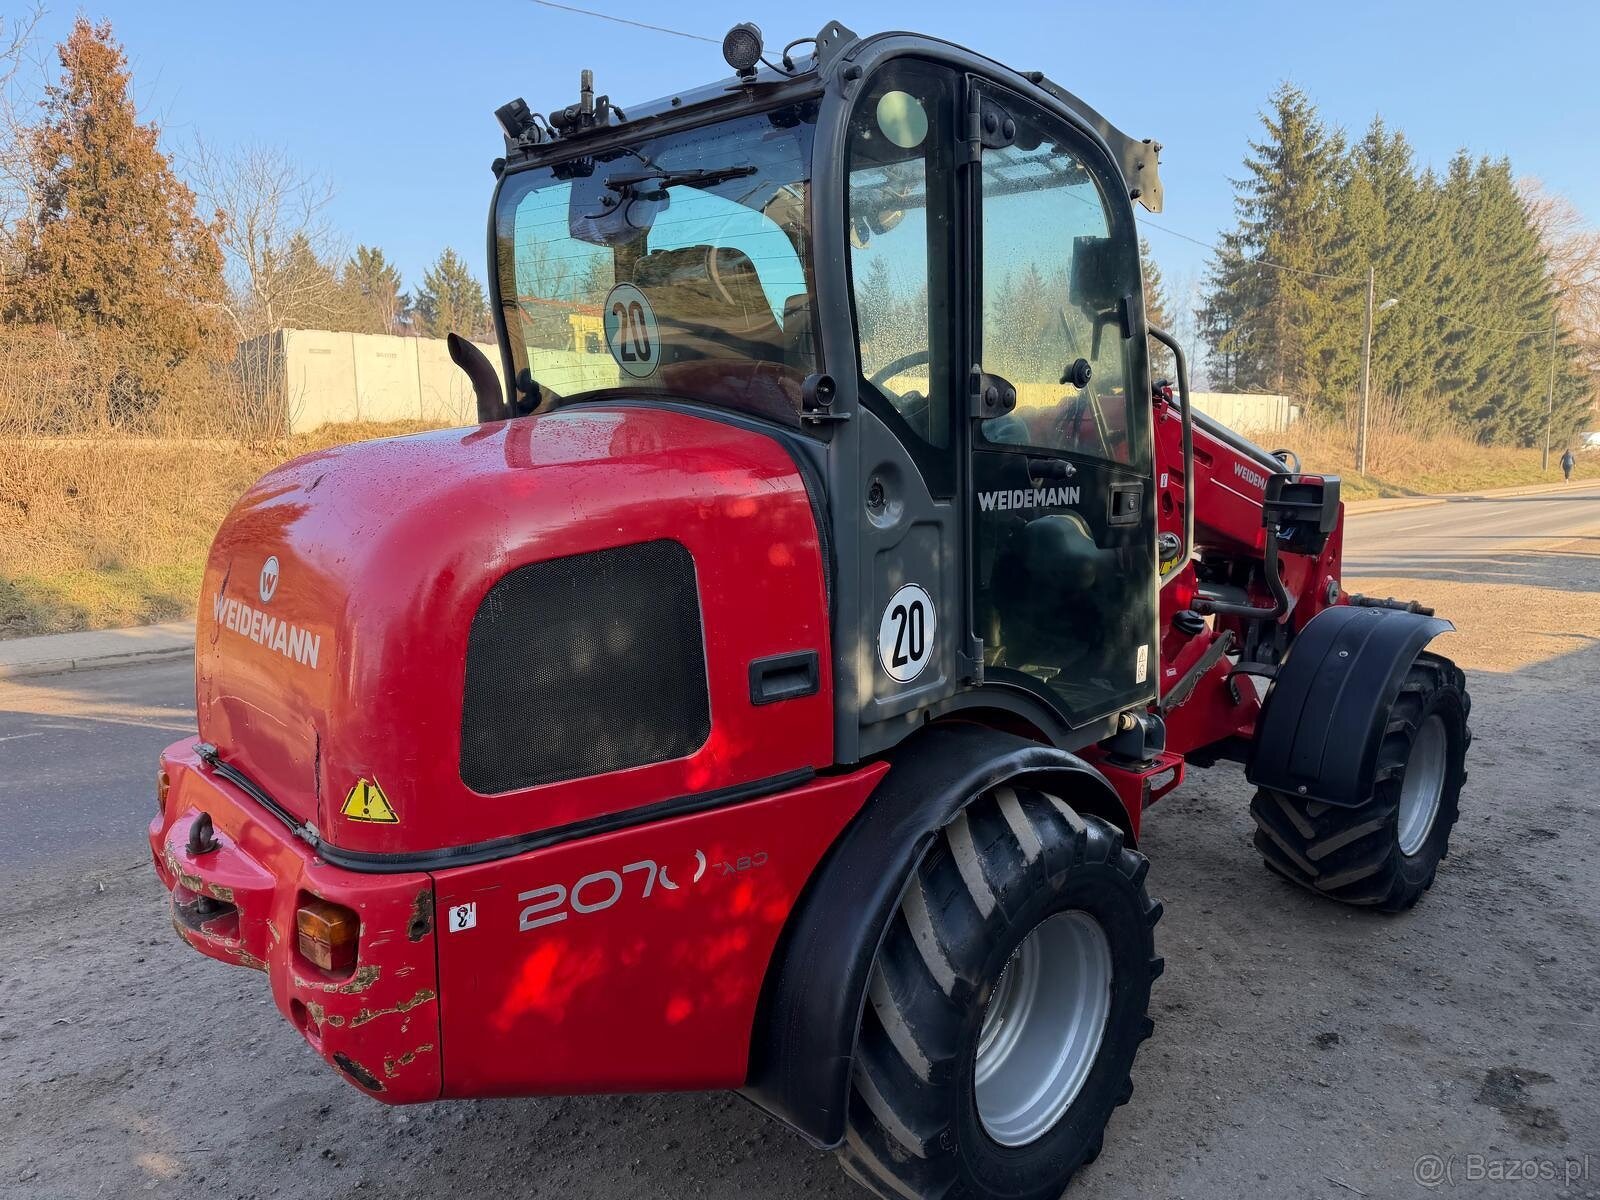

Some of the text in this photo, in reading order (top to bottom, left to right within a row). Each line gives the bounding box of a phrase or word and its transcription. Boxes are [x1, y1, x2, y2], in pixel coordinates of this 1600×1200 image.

[612, 300, 652, 362] 20
[977, 485, 1081, 512] WEIDEMANN
[213, 592, 321, 669] WEIDEMANN
[891, 599, 926, 669] 20
